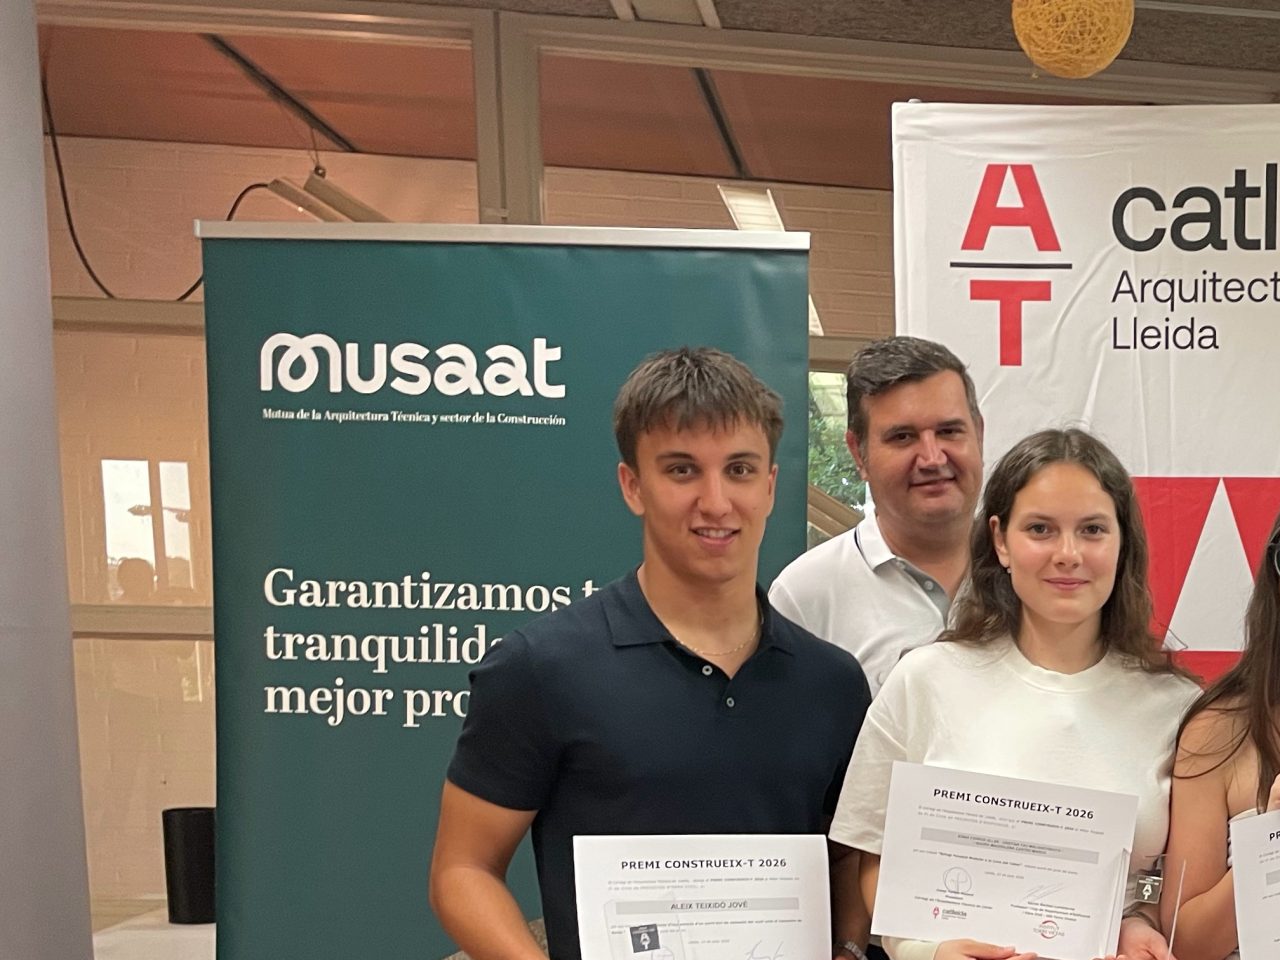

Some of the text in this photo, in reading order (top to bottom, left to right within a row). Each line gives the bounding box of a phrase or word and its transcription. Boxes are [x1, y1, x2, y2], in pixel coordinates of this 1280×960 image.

[1111, 317, 1219, 350] Lleida
[263, 408, 565, 425] Mutua de la Arquitectura Técnica y sector de la Construcción
[264, 568, 572, 612] Garantizamos
[264, 677, 470, 728] mejor pro
[934, 789, 1094, 820] PREMI CONSTRUEIX-T 2026
[621, 858, 787, 870] PREMI CONSTRUEIX-T 2026
[670, 902, 693, 910] ALEIX
